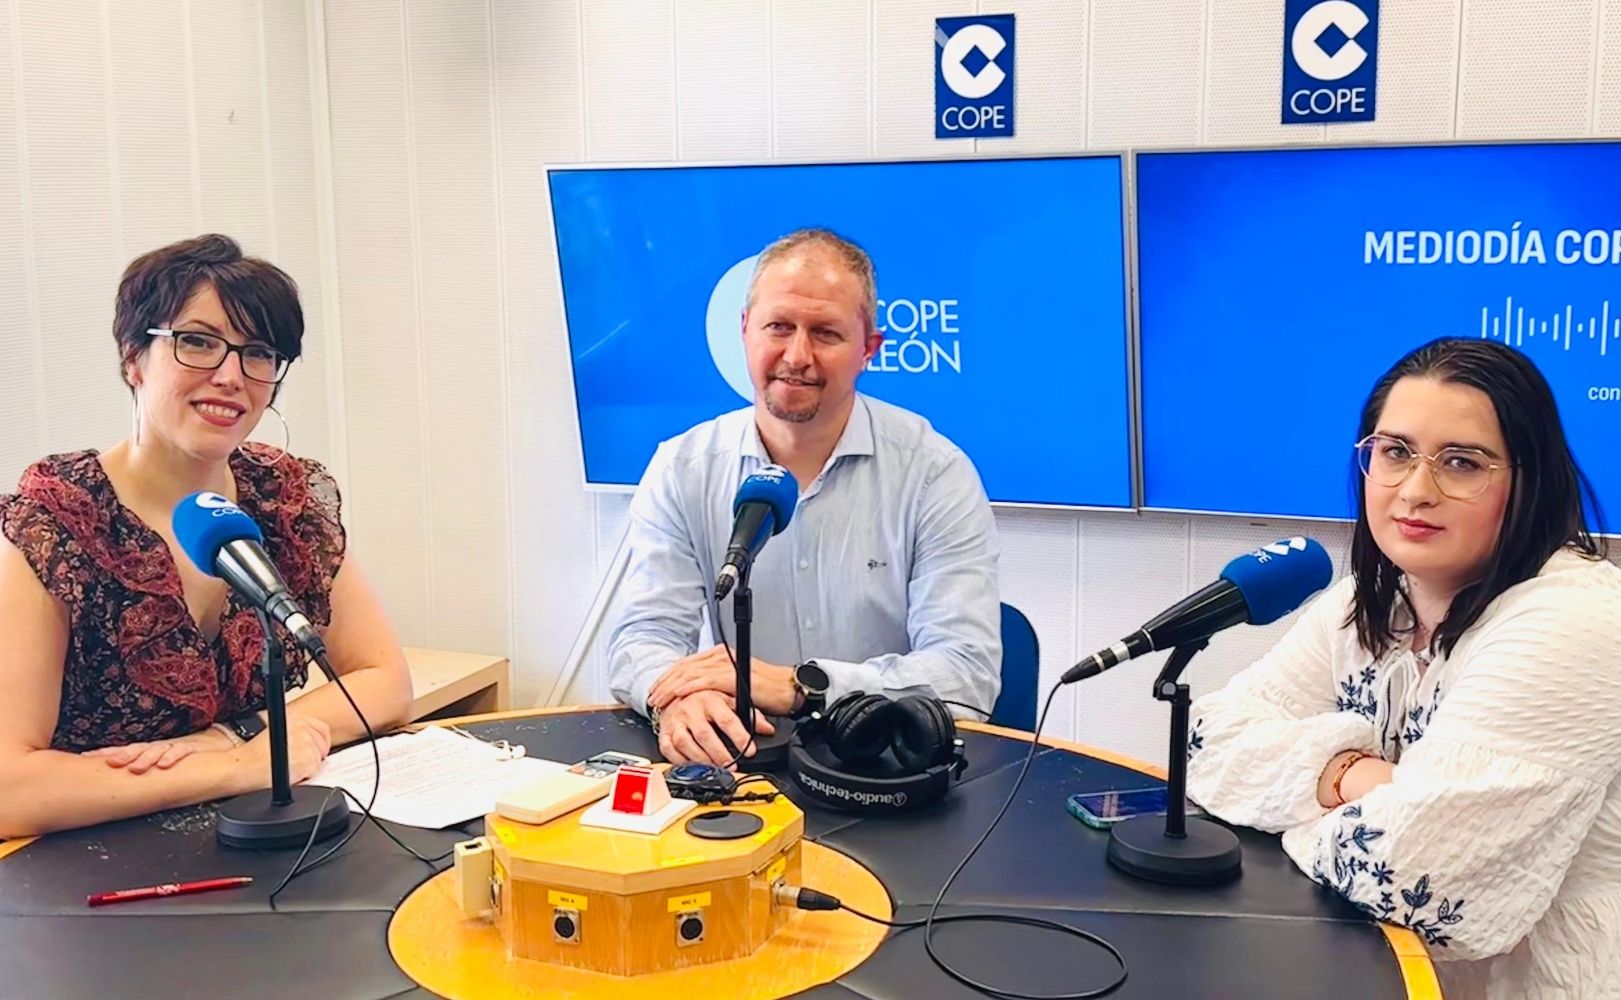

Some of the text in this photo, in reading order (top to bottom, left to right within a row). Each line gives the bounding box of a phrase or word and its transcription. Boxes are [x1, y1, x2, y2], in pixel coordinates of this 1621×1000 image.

[1290, 87, 1367, 116] COPE
[941, 105, 1006, 131] COPE
[1363, 221, 1547, 265] MEDIODÍA
[1588, 386, 1621, 401] con
[798, 770, 894, 806] audio-technica
